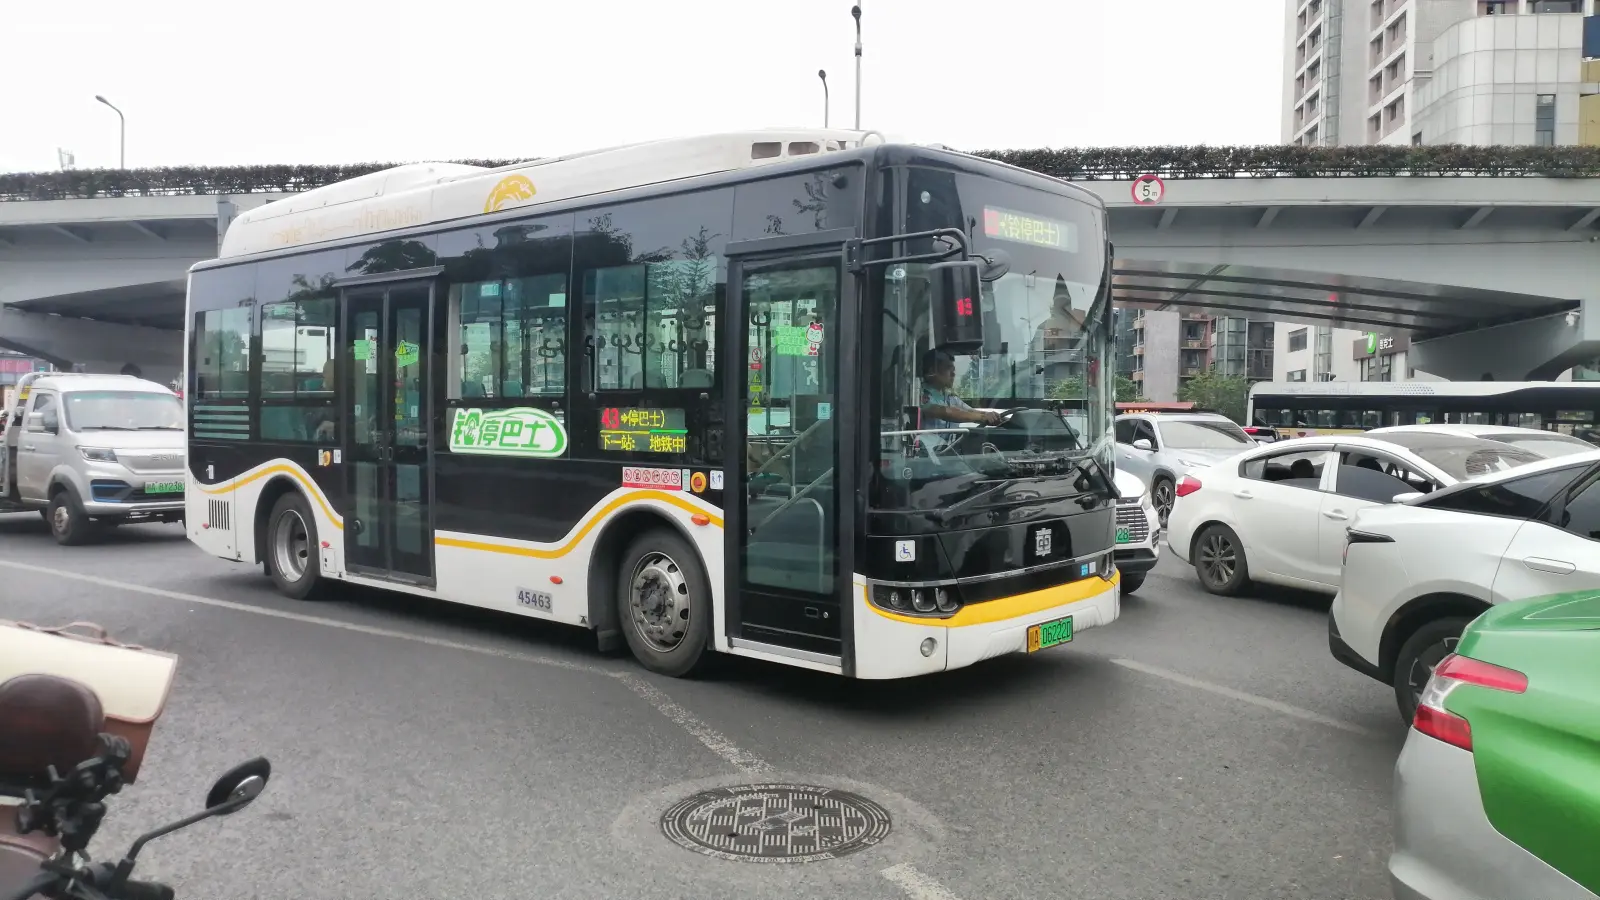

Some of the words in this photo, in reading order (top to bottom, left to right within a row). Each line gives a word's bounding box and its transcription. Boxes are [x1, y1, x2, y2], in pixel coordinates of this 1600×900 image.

[600, 407, 620, 429] 43
[649, 434, 686, 453] 地铁中
[517, 590, 551, 610] 45463
